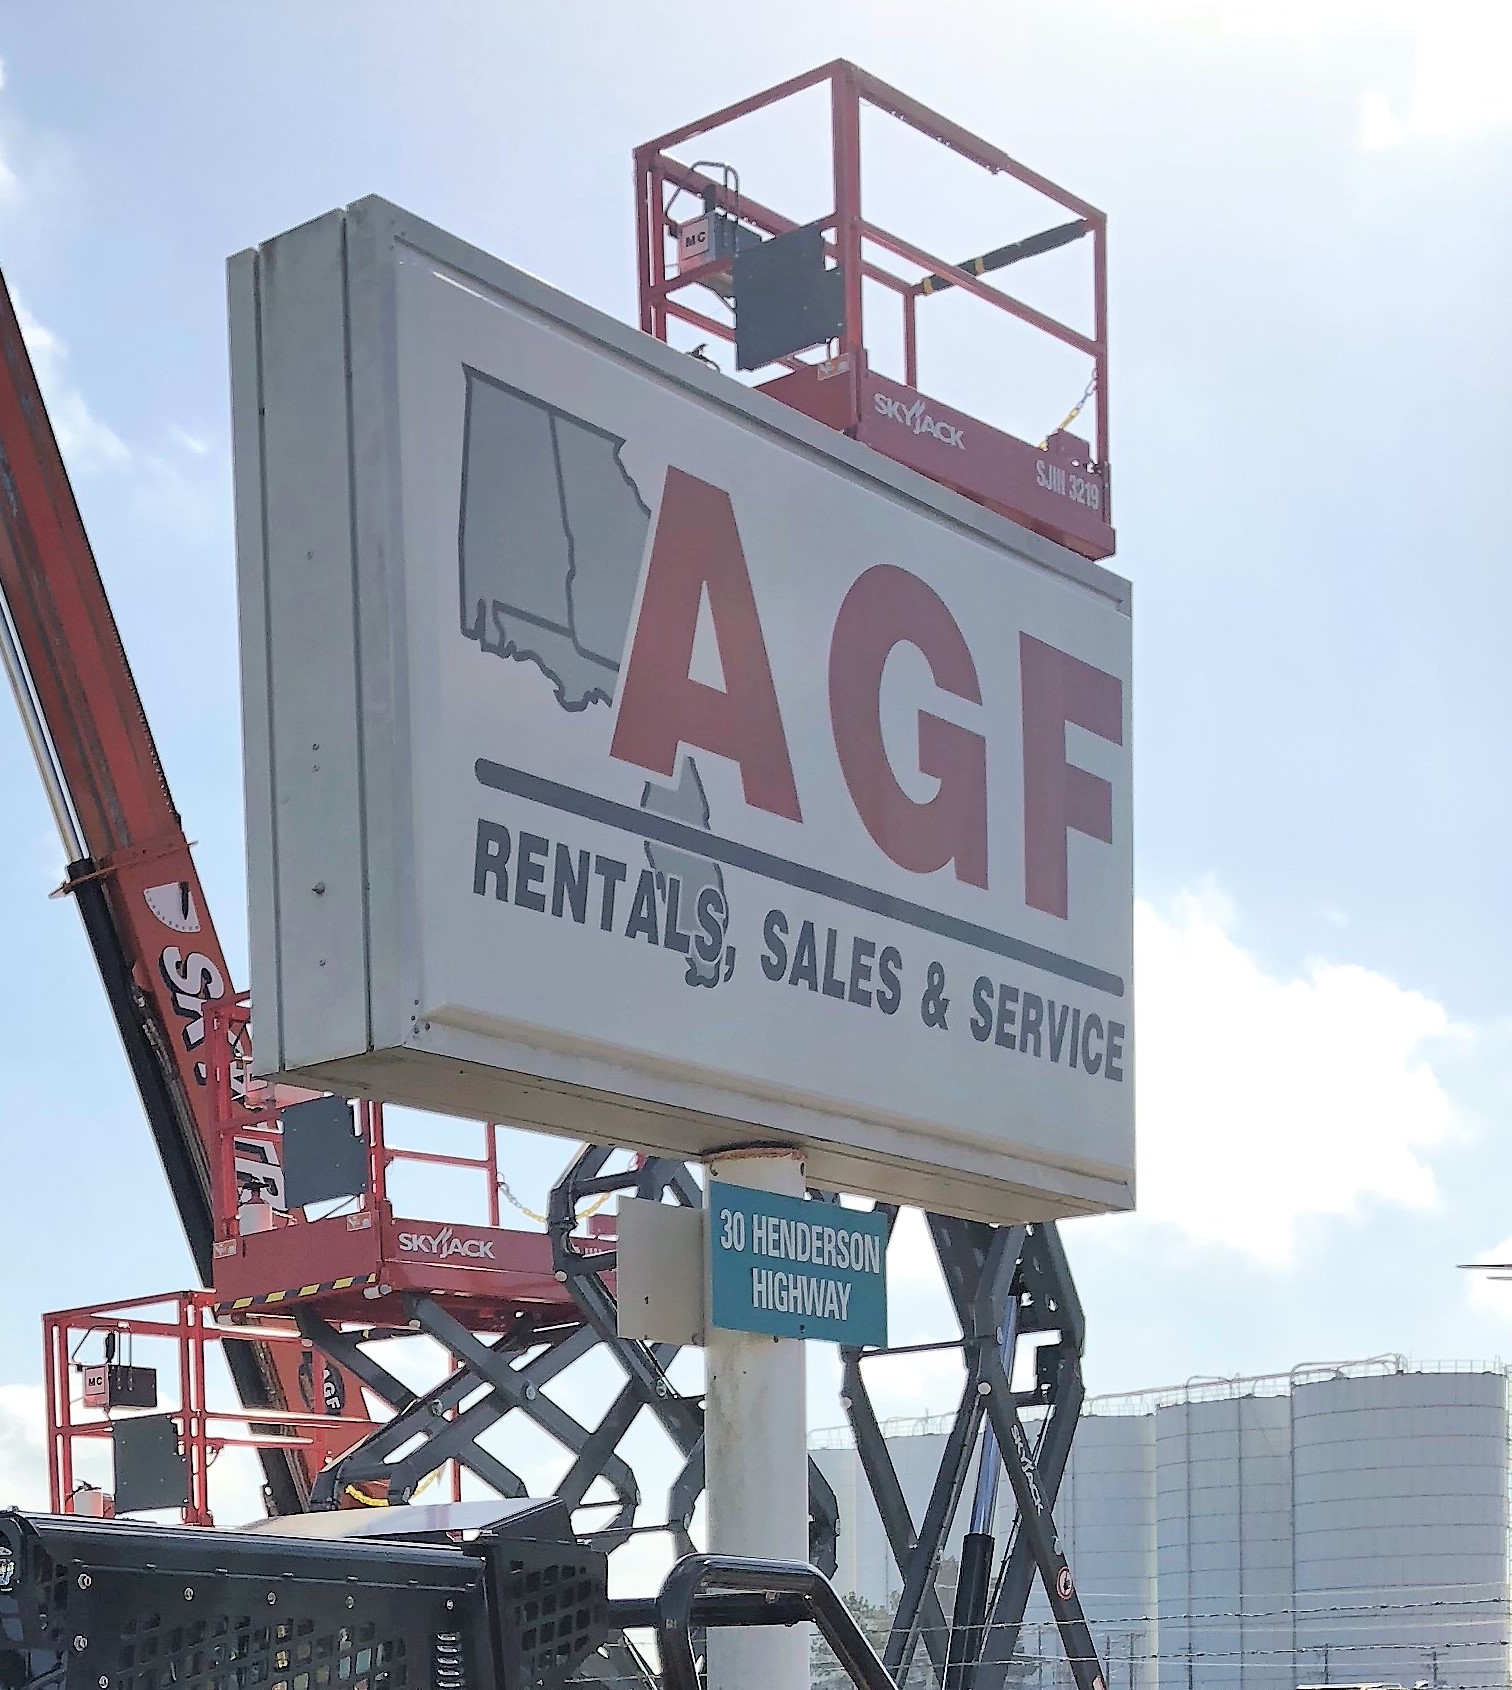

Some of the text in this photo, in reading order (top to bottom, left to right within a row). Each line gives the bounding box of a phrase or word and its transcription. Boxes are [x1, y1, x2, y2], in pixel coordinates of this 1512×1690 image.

[685, 231, 706, 248] MC
[873, 392, 966, 451] SKYJACK
[1069, 474, 1099, 510] 3219
[610, 466, 1123, 920] AGF
[473, 818, 1125, 1082] RENTALS, SALES & SERVICE
[398, 1226, 496, 1259] SKYJACK
[719, 1208, 880, 1275] 30 HENDERSON
[751, 1267, 852, 1321] HIGHWAY
[88, 1376, 103, 1387] MC
